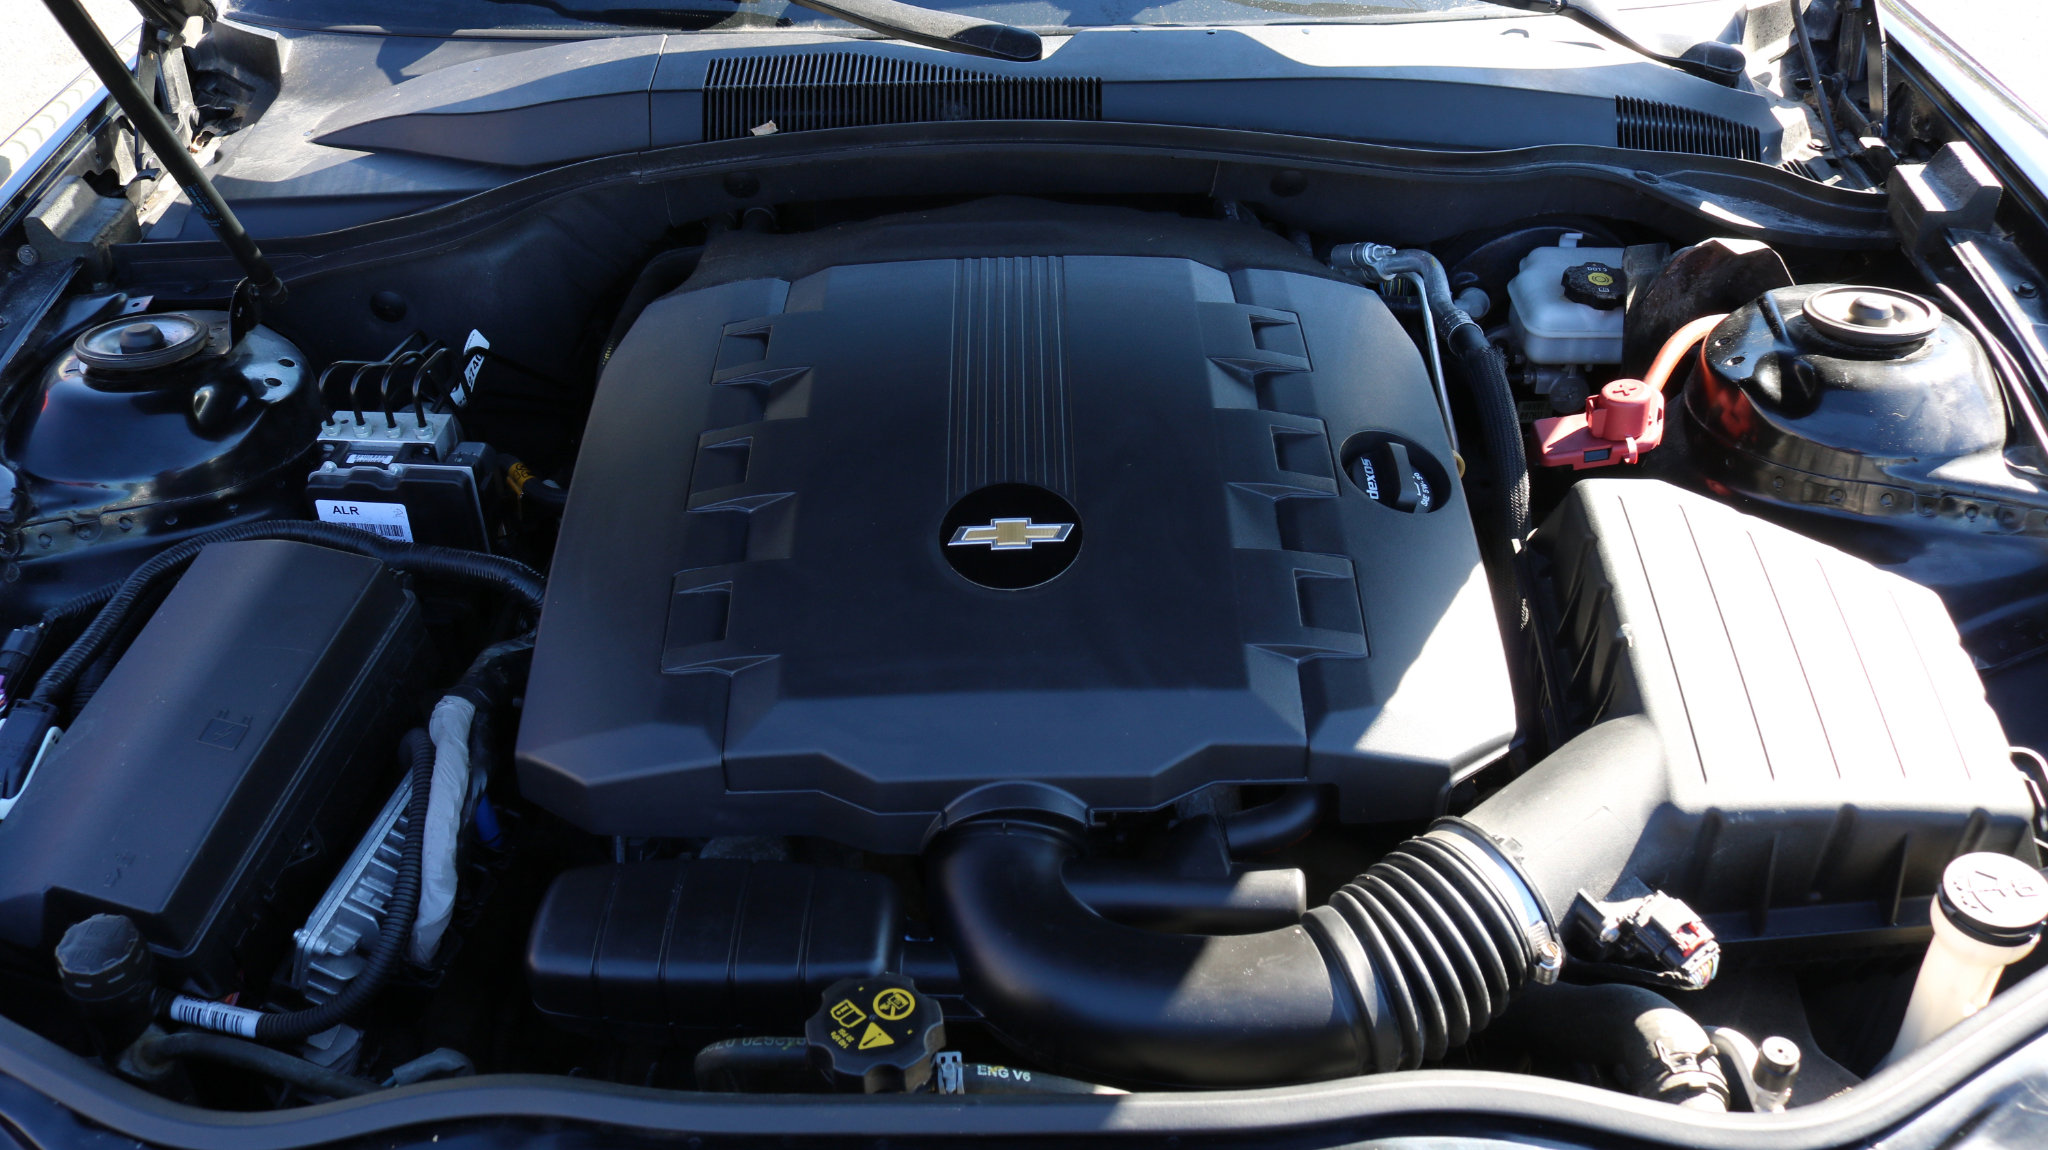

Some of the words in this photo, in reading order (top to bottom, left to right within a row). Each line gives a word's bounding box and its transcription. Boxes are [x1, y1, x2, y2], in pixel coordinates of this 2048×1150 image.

[1360, 457, 1379, 500] dexos
[1420, 495, 1430, 507] SAE
[332, 505, 360, 516] ALR
[977, 1065, 1010, 1079] ENG
[1012, 1069, 1032, 1082] V6
